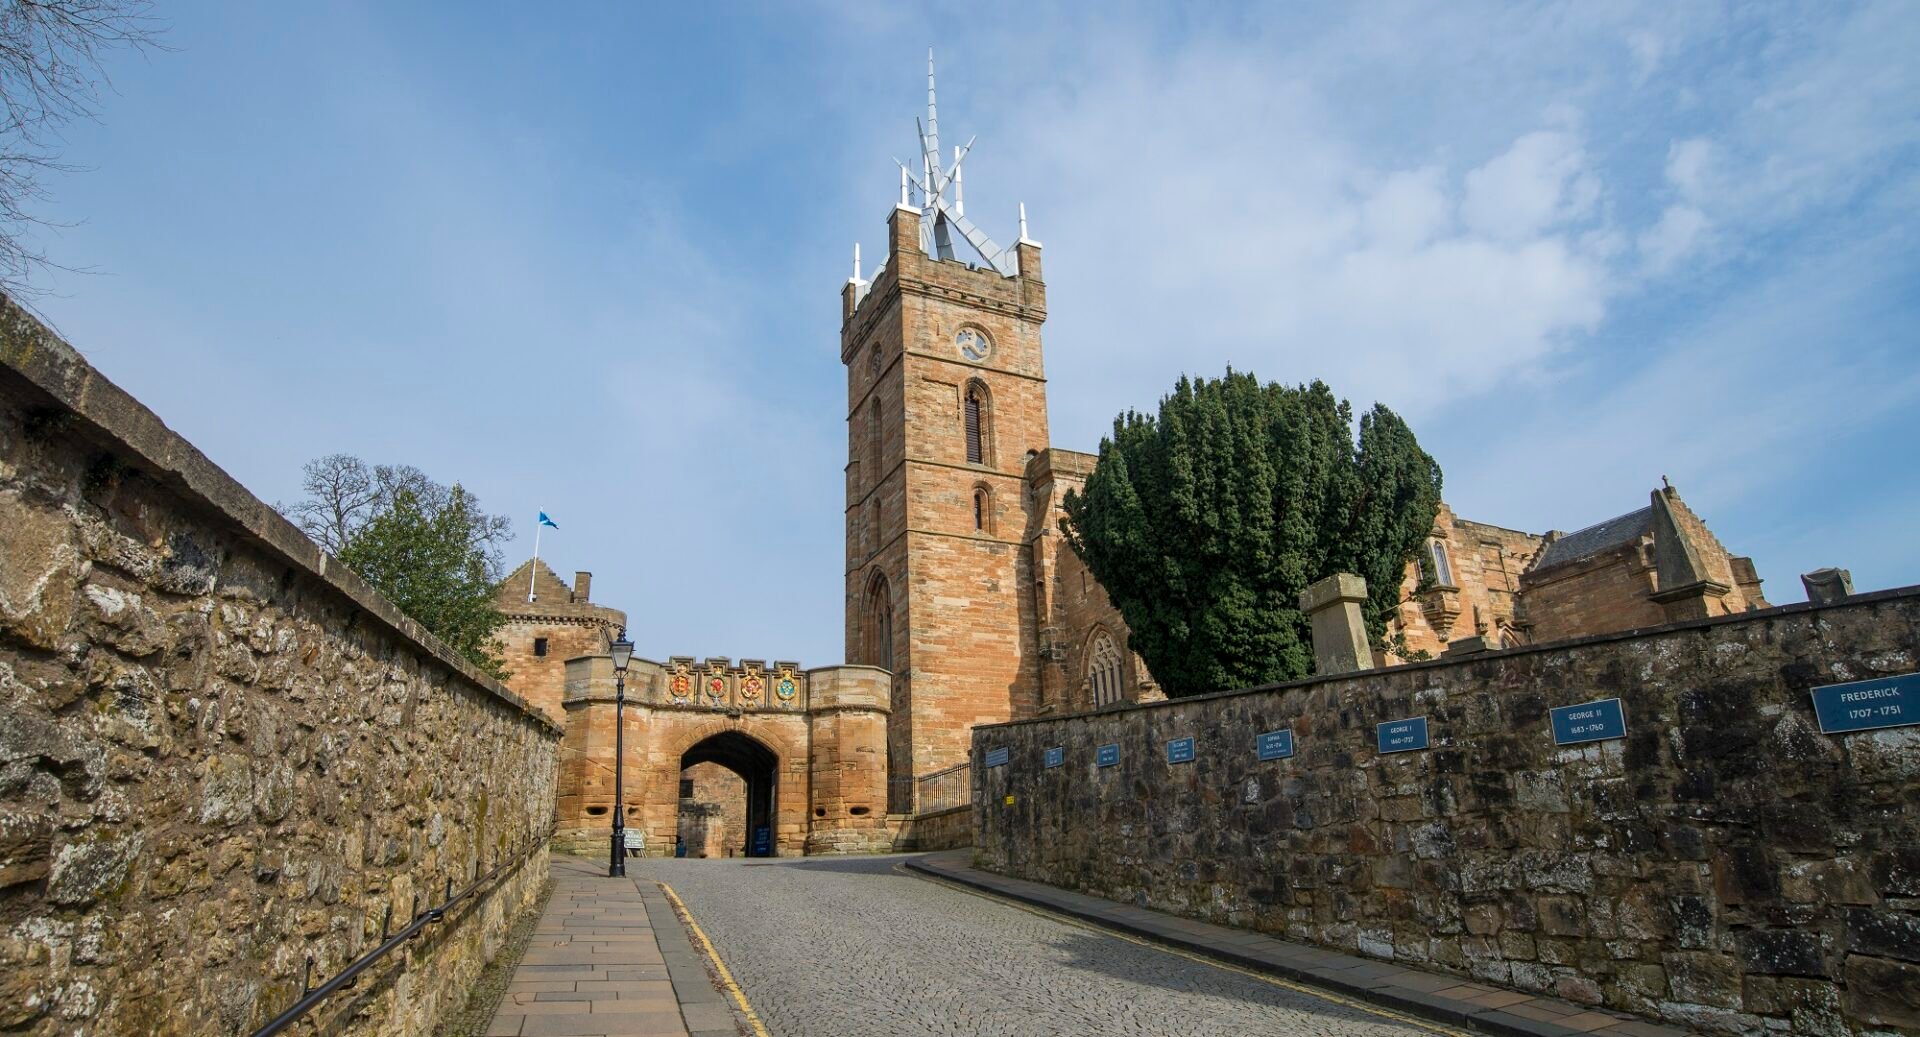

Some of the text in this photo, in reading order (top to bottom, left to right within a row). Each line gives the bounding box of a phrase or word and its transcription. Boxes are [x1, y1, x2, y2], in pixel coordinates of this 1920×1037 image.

[1840, 686, 1900, 702] FREDERICK
[1568, 710, 1594, 720] GEORGE
[1390, 726, 1408, 734] GEORGE
